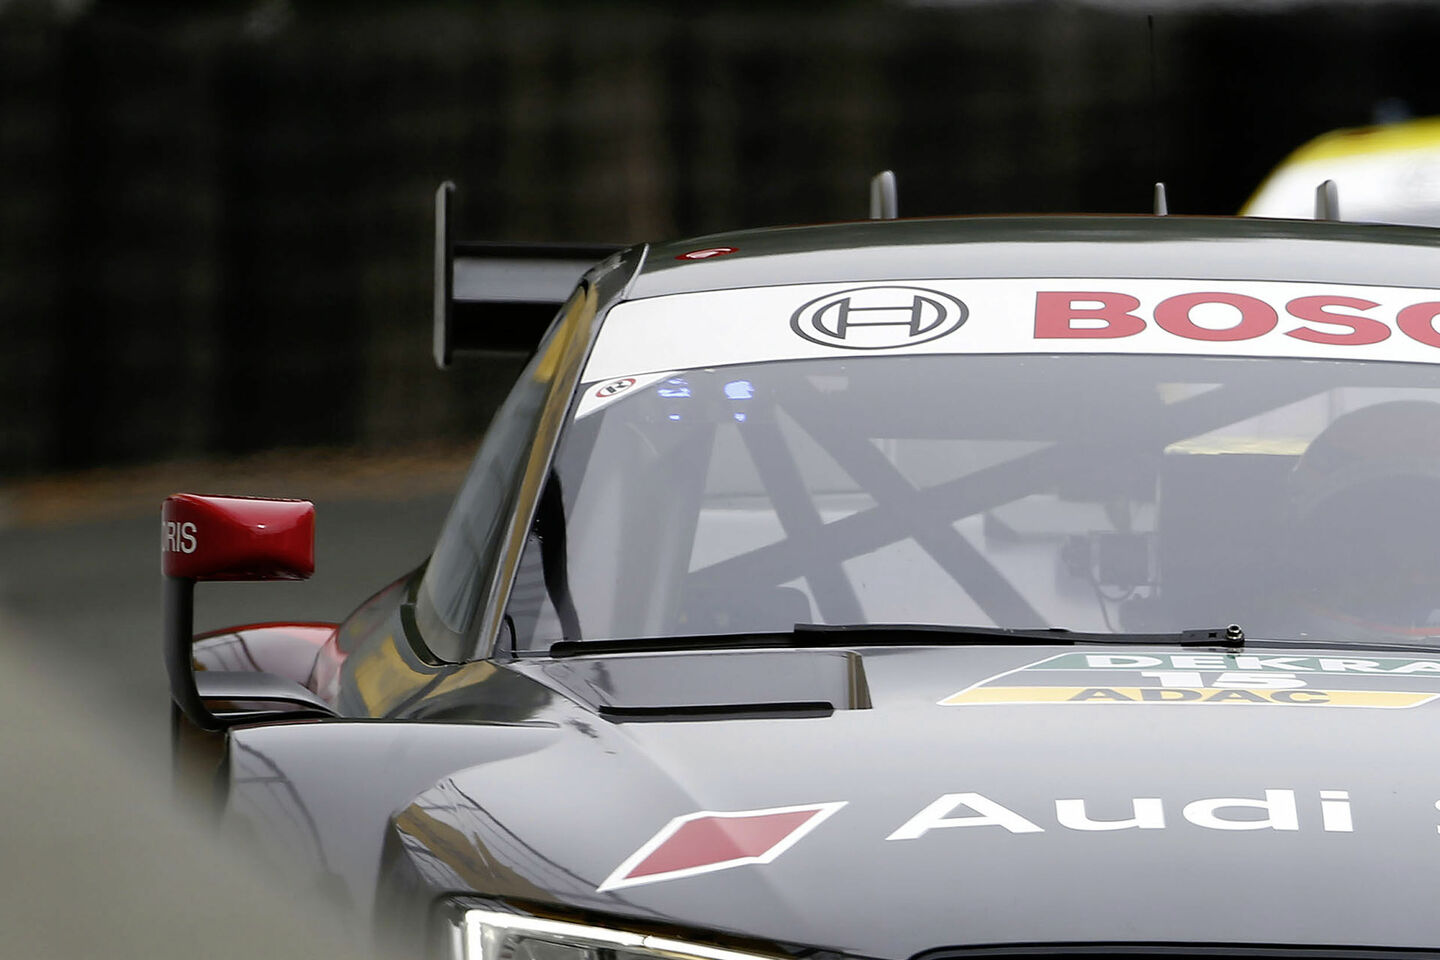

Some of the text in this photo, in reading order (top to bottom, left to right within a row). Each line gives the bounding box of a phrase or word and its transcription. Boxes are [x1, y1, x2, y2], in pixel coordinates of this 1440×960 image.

[162, 522, 198, 553] RIS
[1141, 671, 1307, 689] 15
[1067, 687, 1330, 704] ADAC
[887, 789, 1354, 841] Audi
